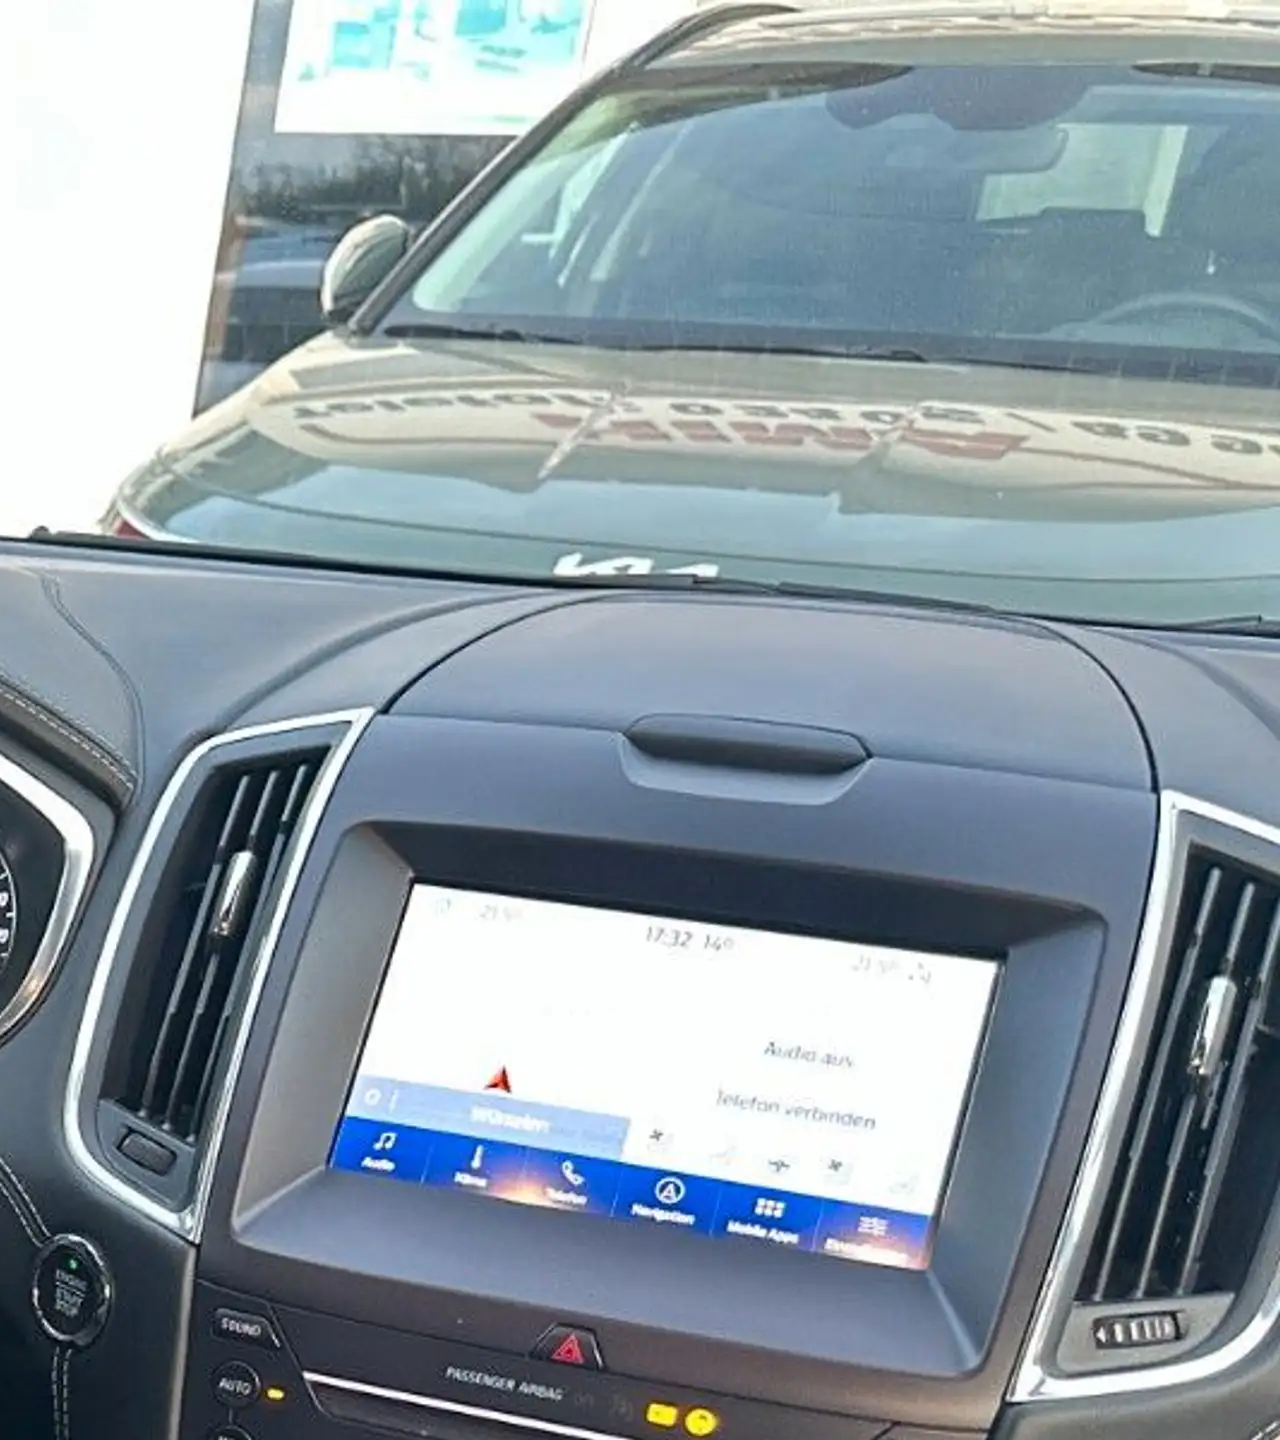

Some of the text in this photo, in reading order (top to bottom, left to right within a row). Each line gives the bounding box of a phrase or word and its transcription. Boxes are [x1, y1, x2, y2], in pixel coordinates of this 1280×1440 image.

[645, 925, 694, 949] 17:32
[762, 1041, 816, 1063] Audio
[221, 1317, 261, 1337] SOUND
[219, 1377, 252, 1395] AUTO
[445, 1365, 517, 1391] PASSENGER
[517, 1380, 565, 1402] AIRBAG
